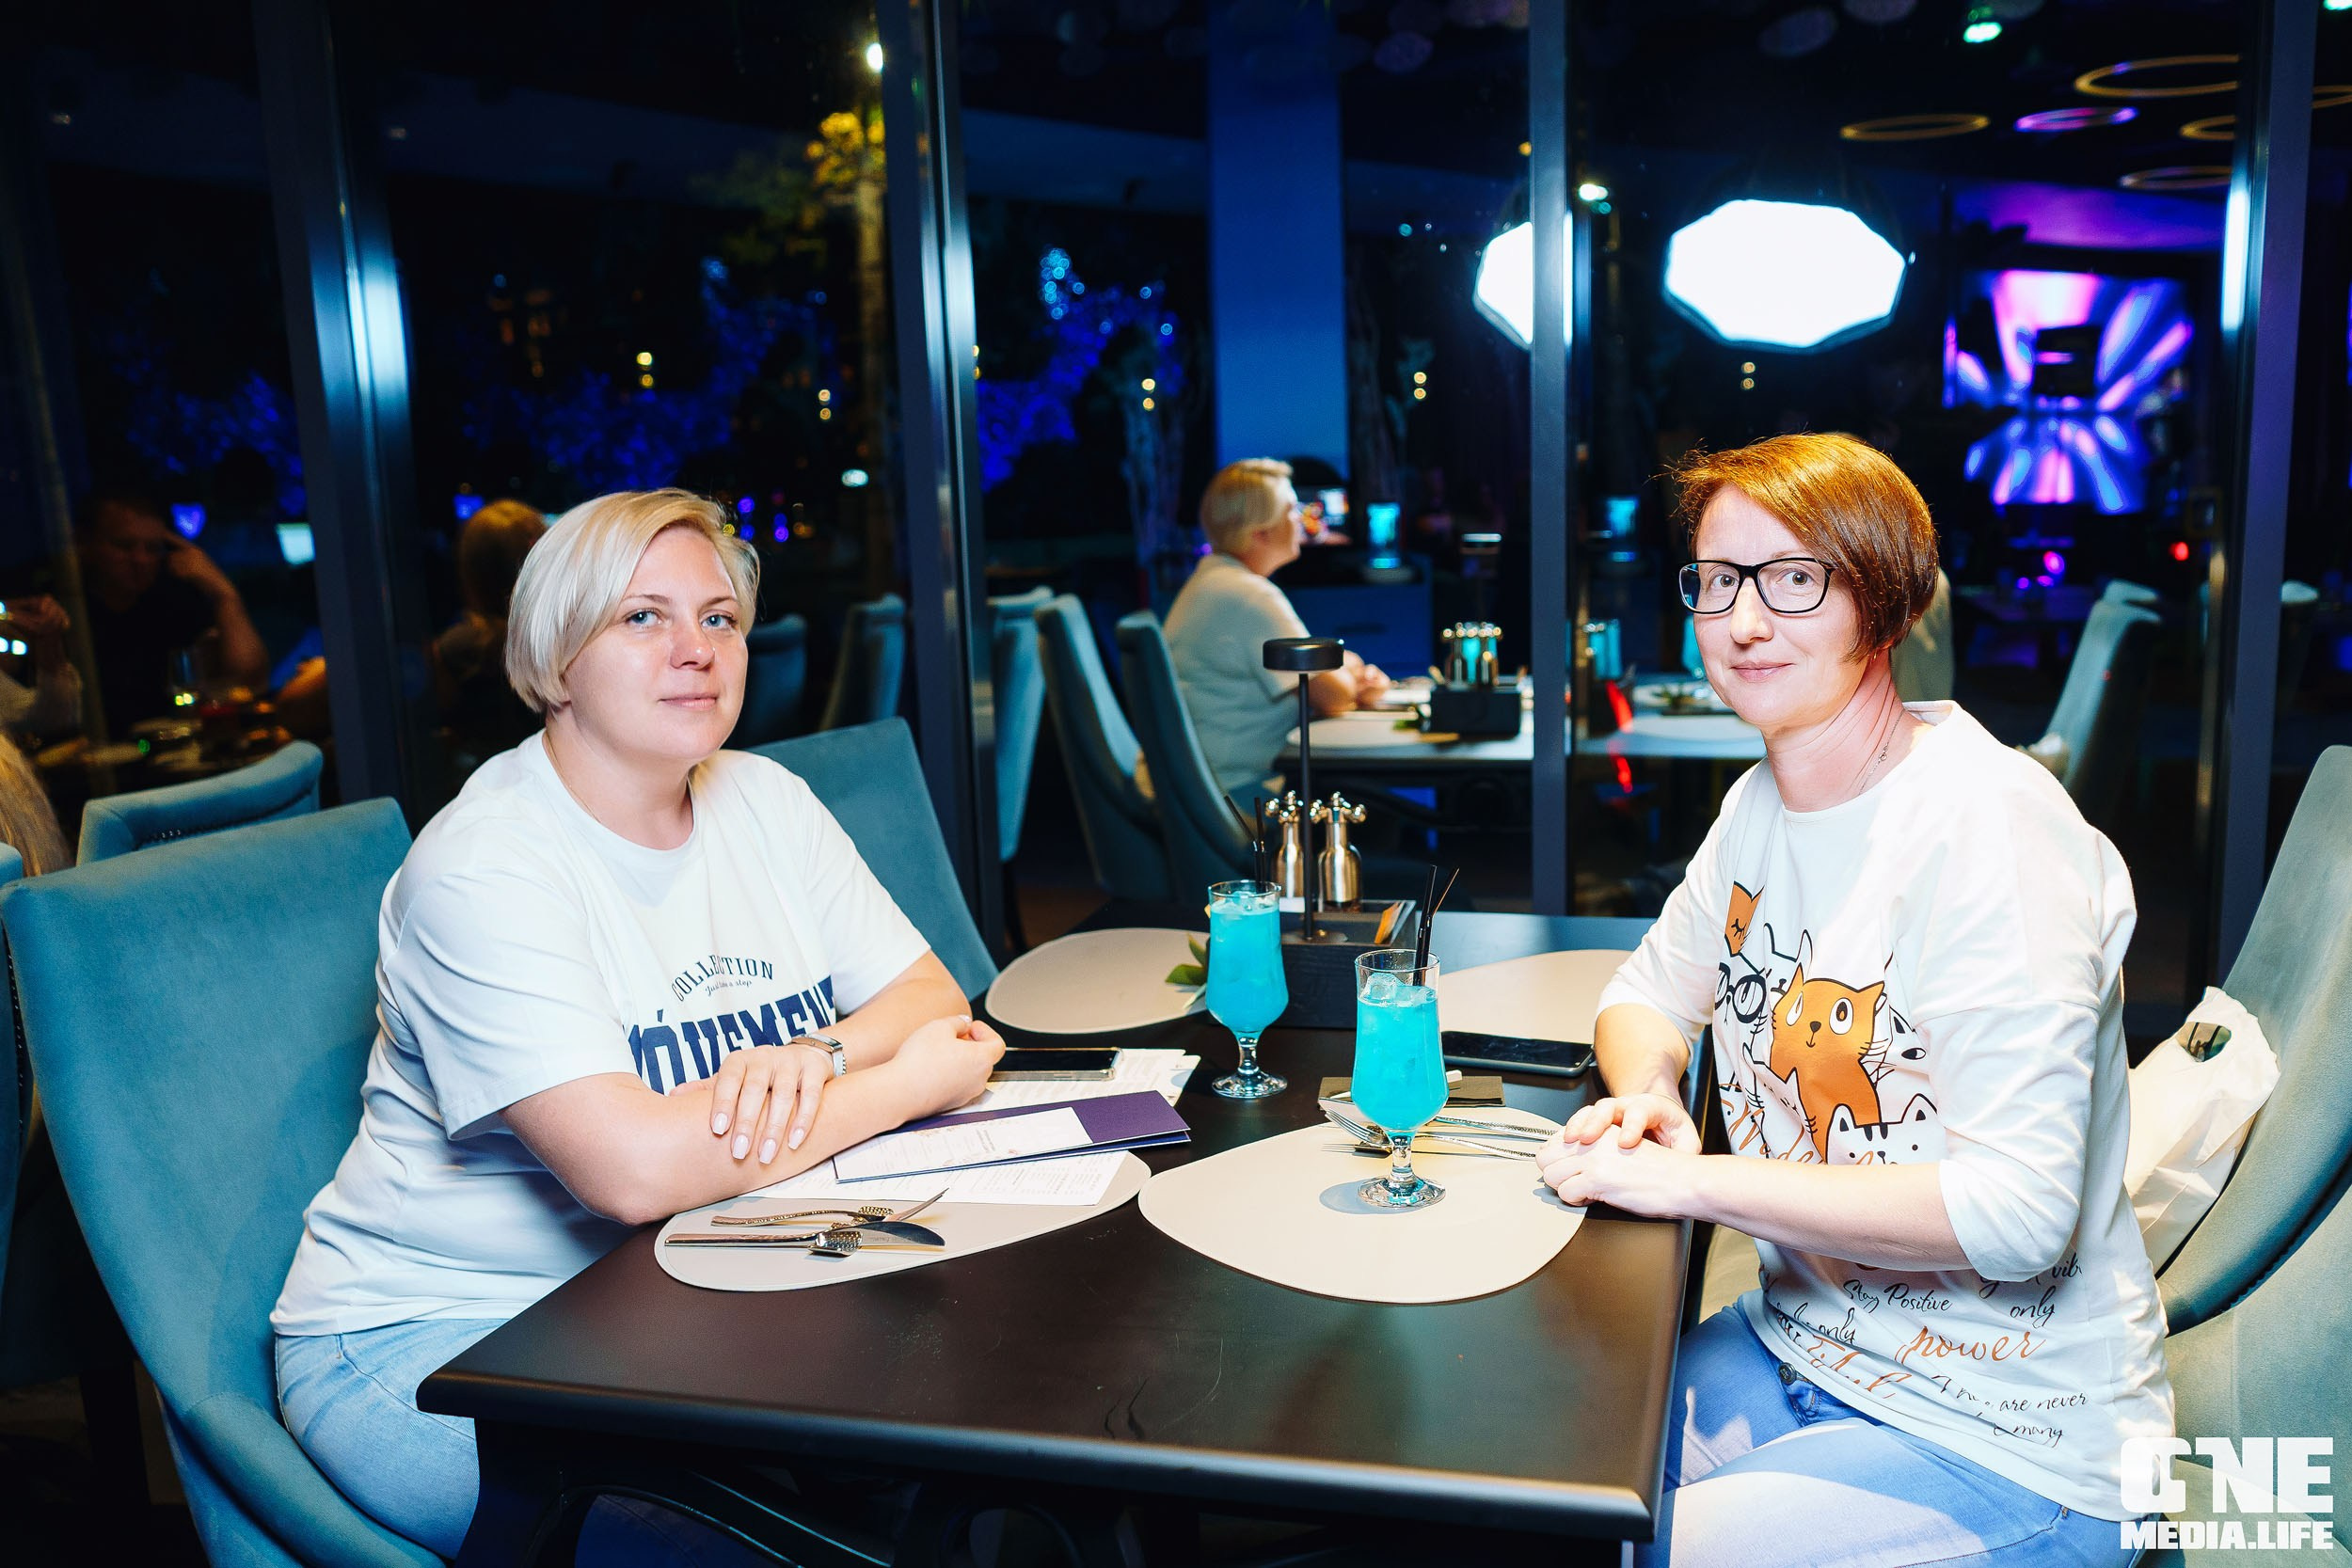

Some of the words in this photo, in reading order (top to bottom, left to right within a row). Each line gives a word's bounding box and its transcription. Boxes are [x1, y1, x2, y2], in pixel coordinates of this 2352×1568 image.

[671, 954, 774, 1003] COLLECTION
[1842, 1278, 1880, 1314] Stay
[1883, 1282, 1953, 1313] Positive
[2010, 1285, 2056, 1329] only
[1818, 1307, 1857, 1345] only
[1894, 1325, 2047, 1365] power
[1999, 1399, 2033, 1412] are
[2036, 1392, 2090, 1410] never
